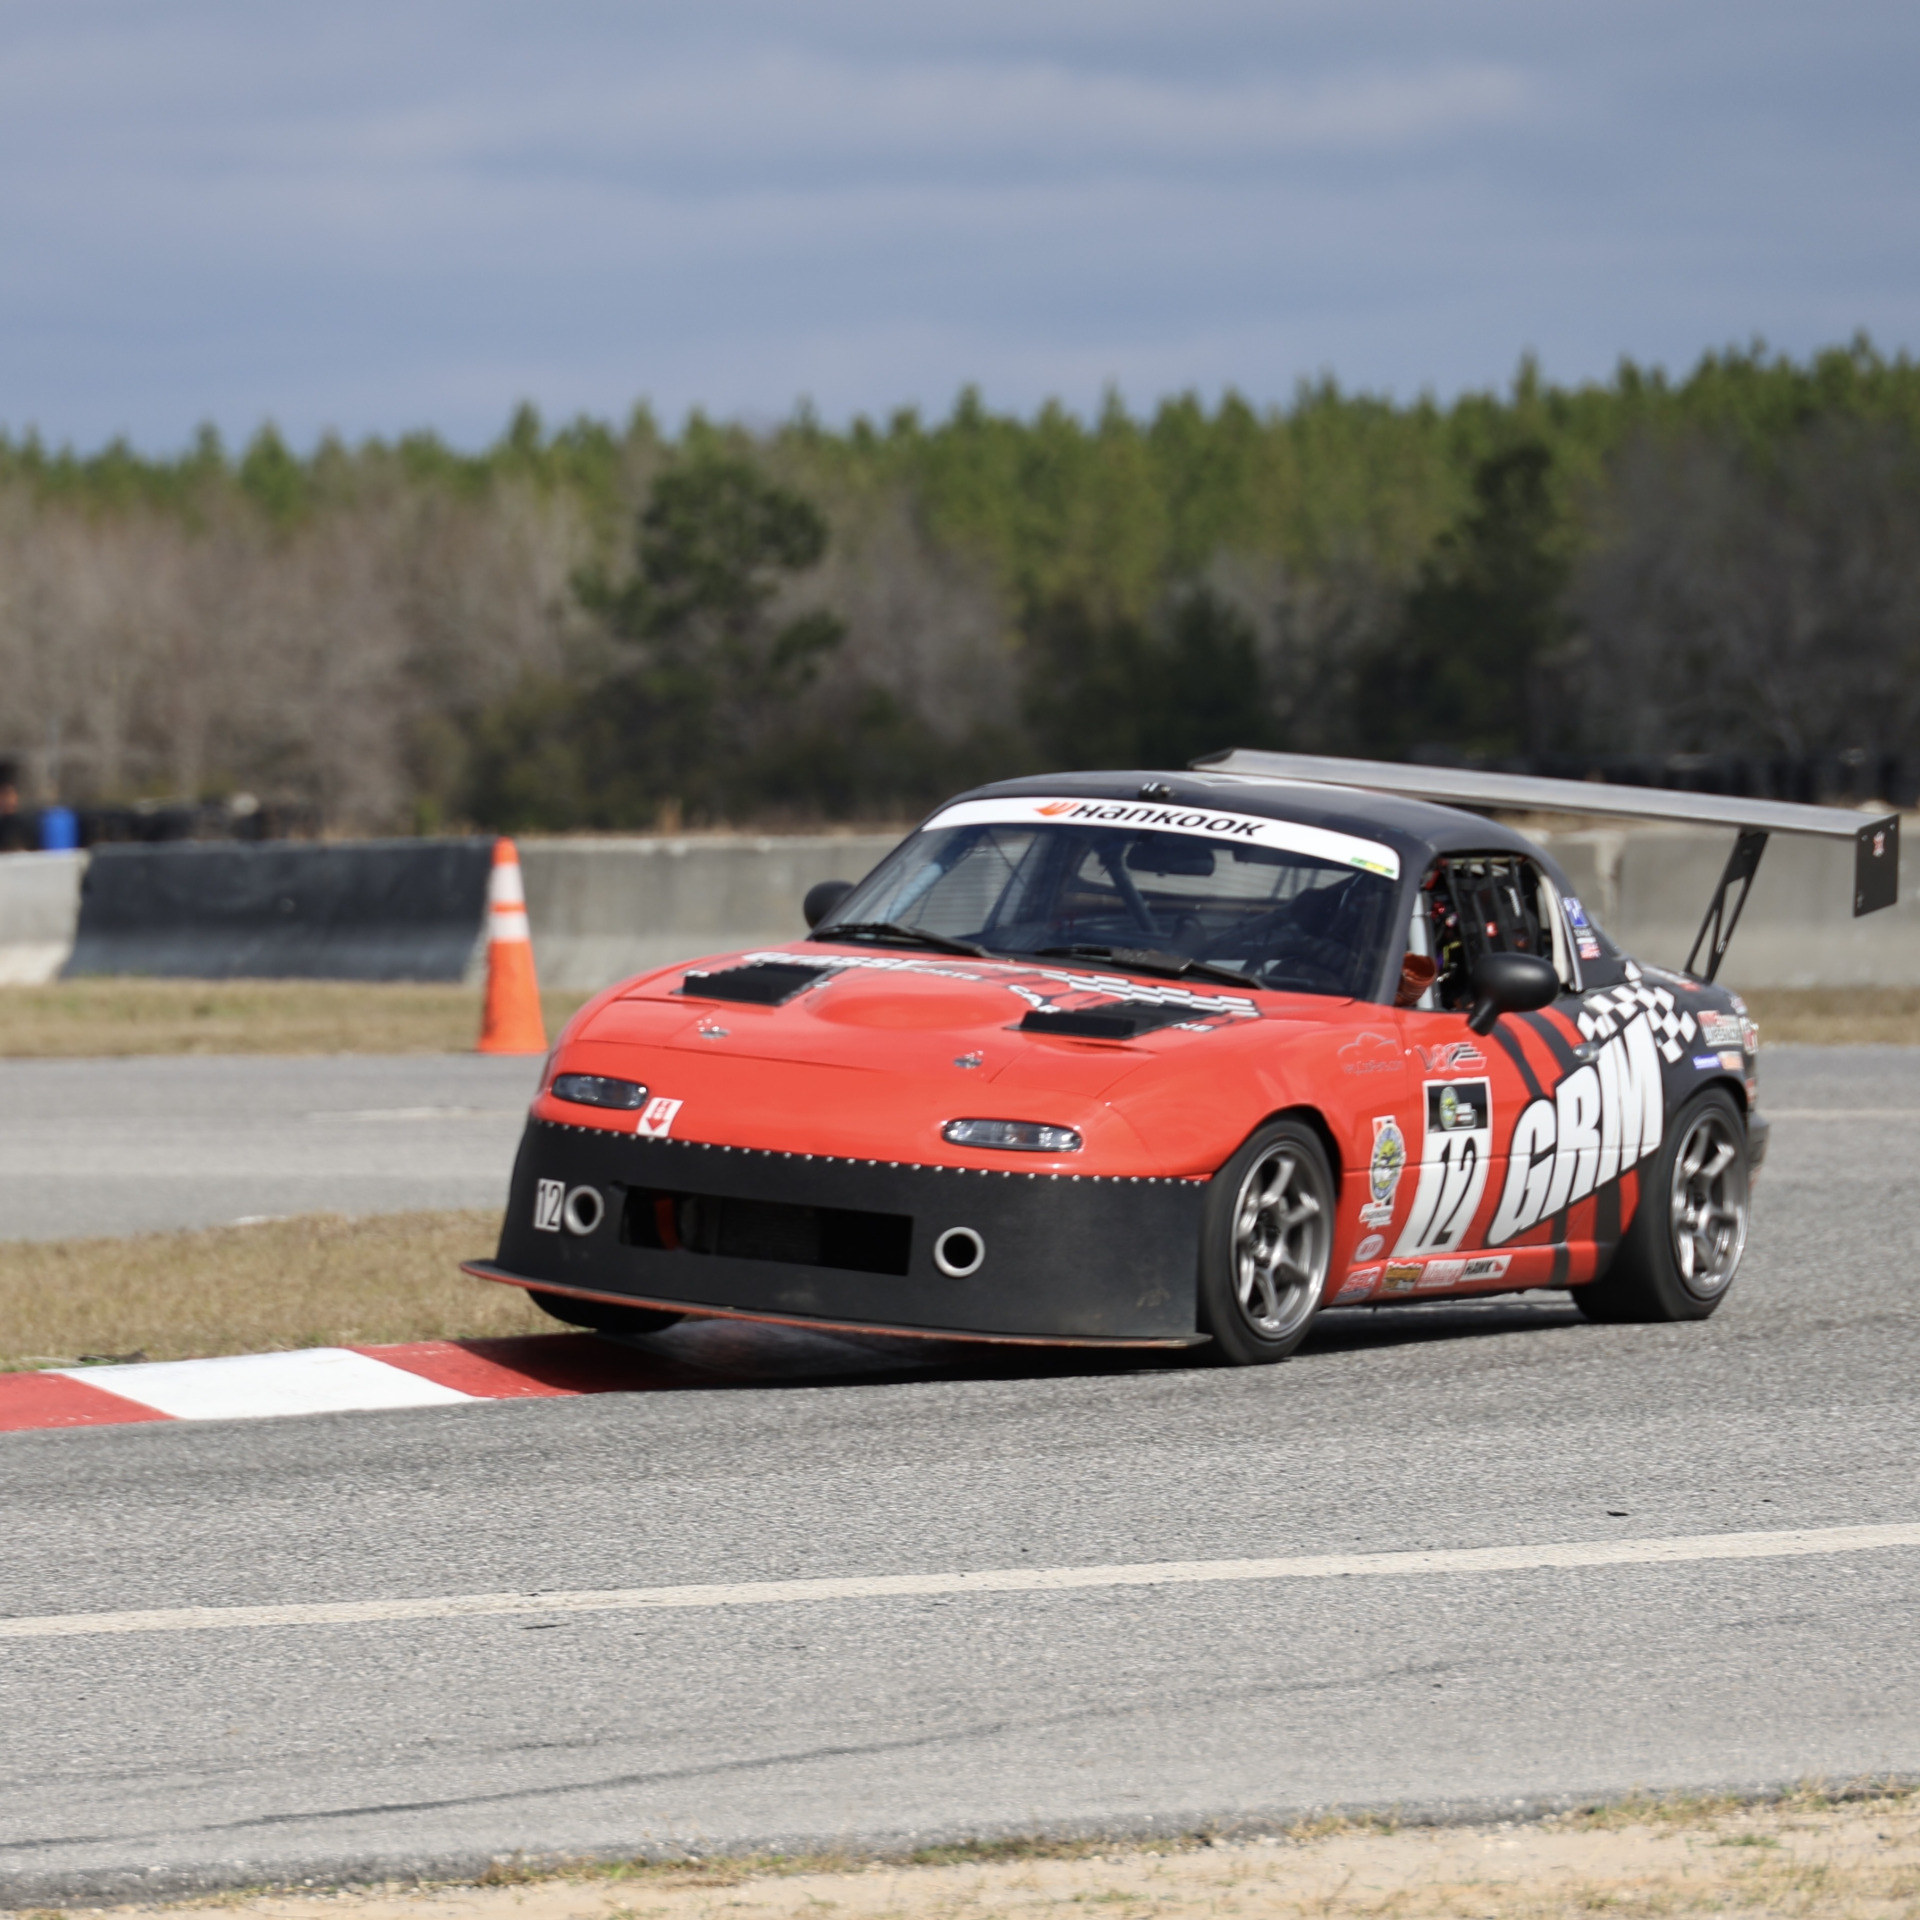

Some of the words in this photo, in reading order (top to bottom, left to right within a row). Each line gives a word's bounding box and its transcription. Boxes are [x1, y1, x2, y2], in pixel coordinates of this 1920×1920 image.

[1486, 1012, 1664, 1247] GRM
[539, 1182, 562, 1227] 12
[1416, 1136, 1478, 1249] 12
